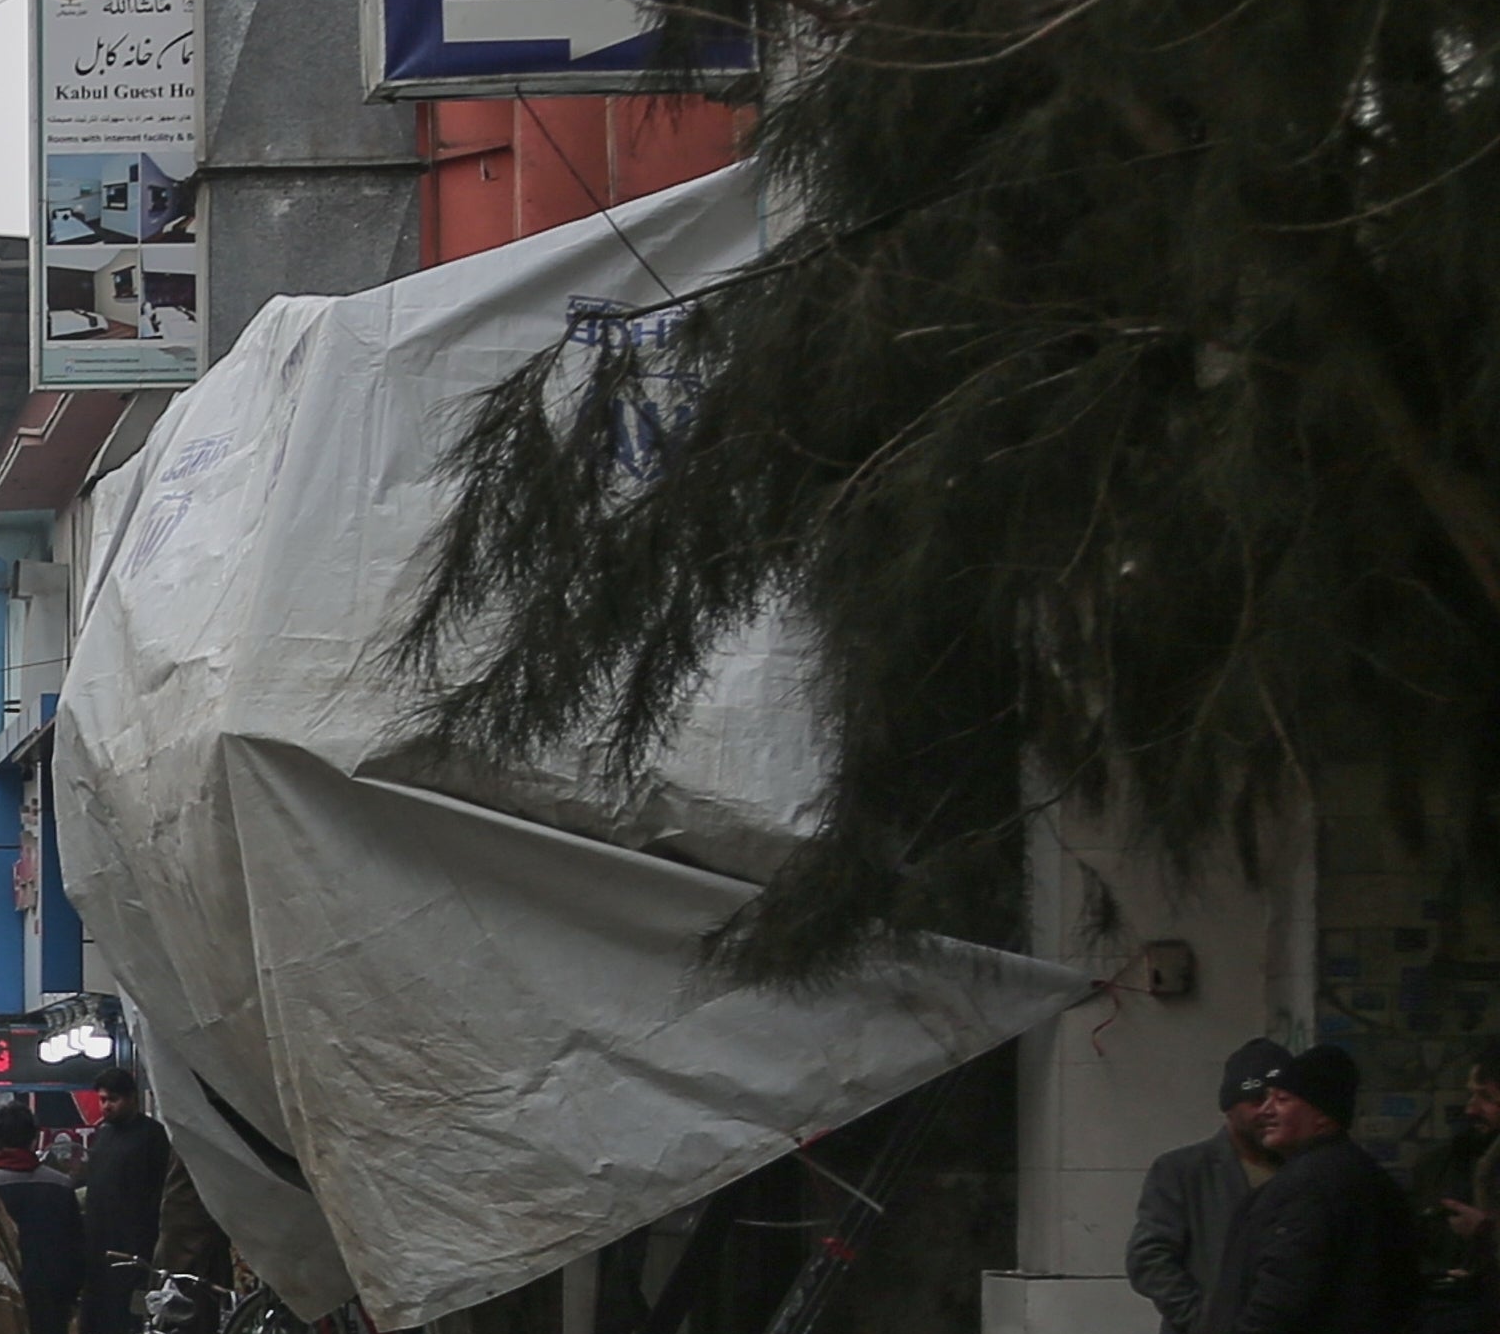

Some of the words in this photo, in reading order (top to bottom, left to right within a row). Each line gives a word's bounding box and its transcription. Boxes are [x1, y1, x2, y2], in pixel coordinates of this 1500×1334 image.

[74, 32, 129, 77] کابل
[55, 84, 108, 101] Kabul
[114, 84, 164, 99] Guest
